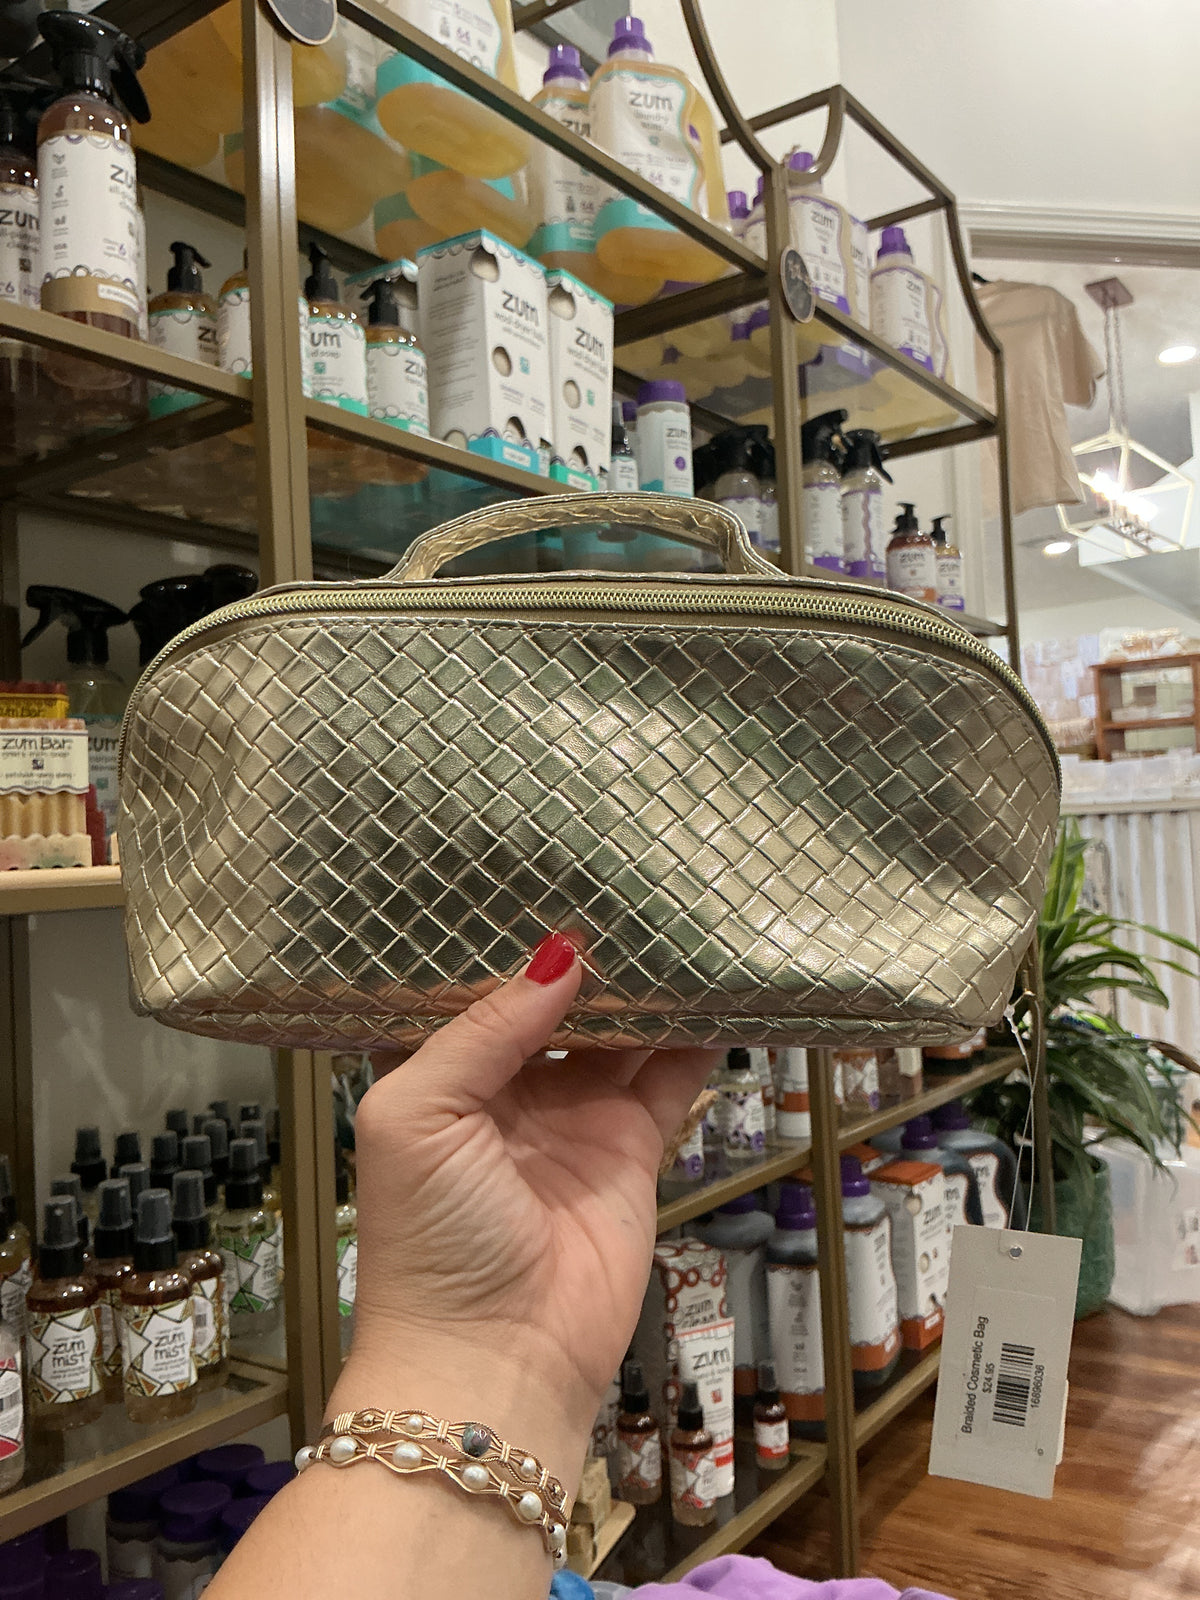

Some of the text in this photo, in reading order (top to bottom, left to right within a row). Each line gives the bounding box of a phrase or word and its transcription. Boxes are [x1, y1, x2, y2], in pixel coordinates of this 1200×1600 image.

[961, 1315, 989, 1434] Braided Cosmetic Bag
[982, 1362, 995, 1394] $24.95
